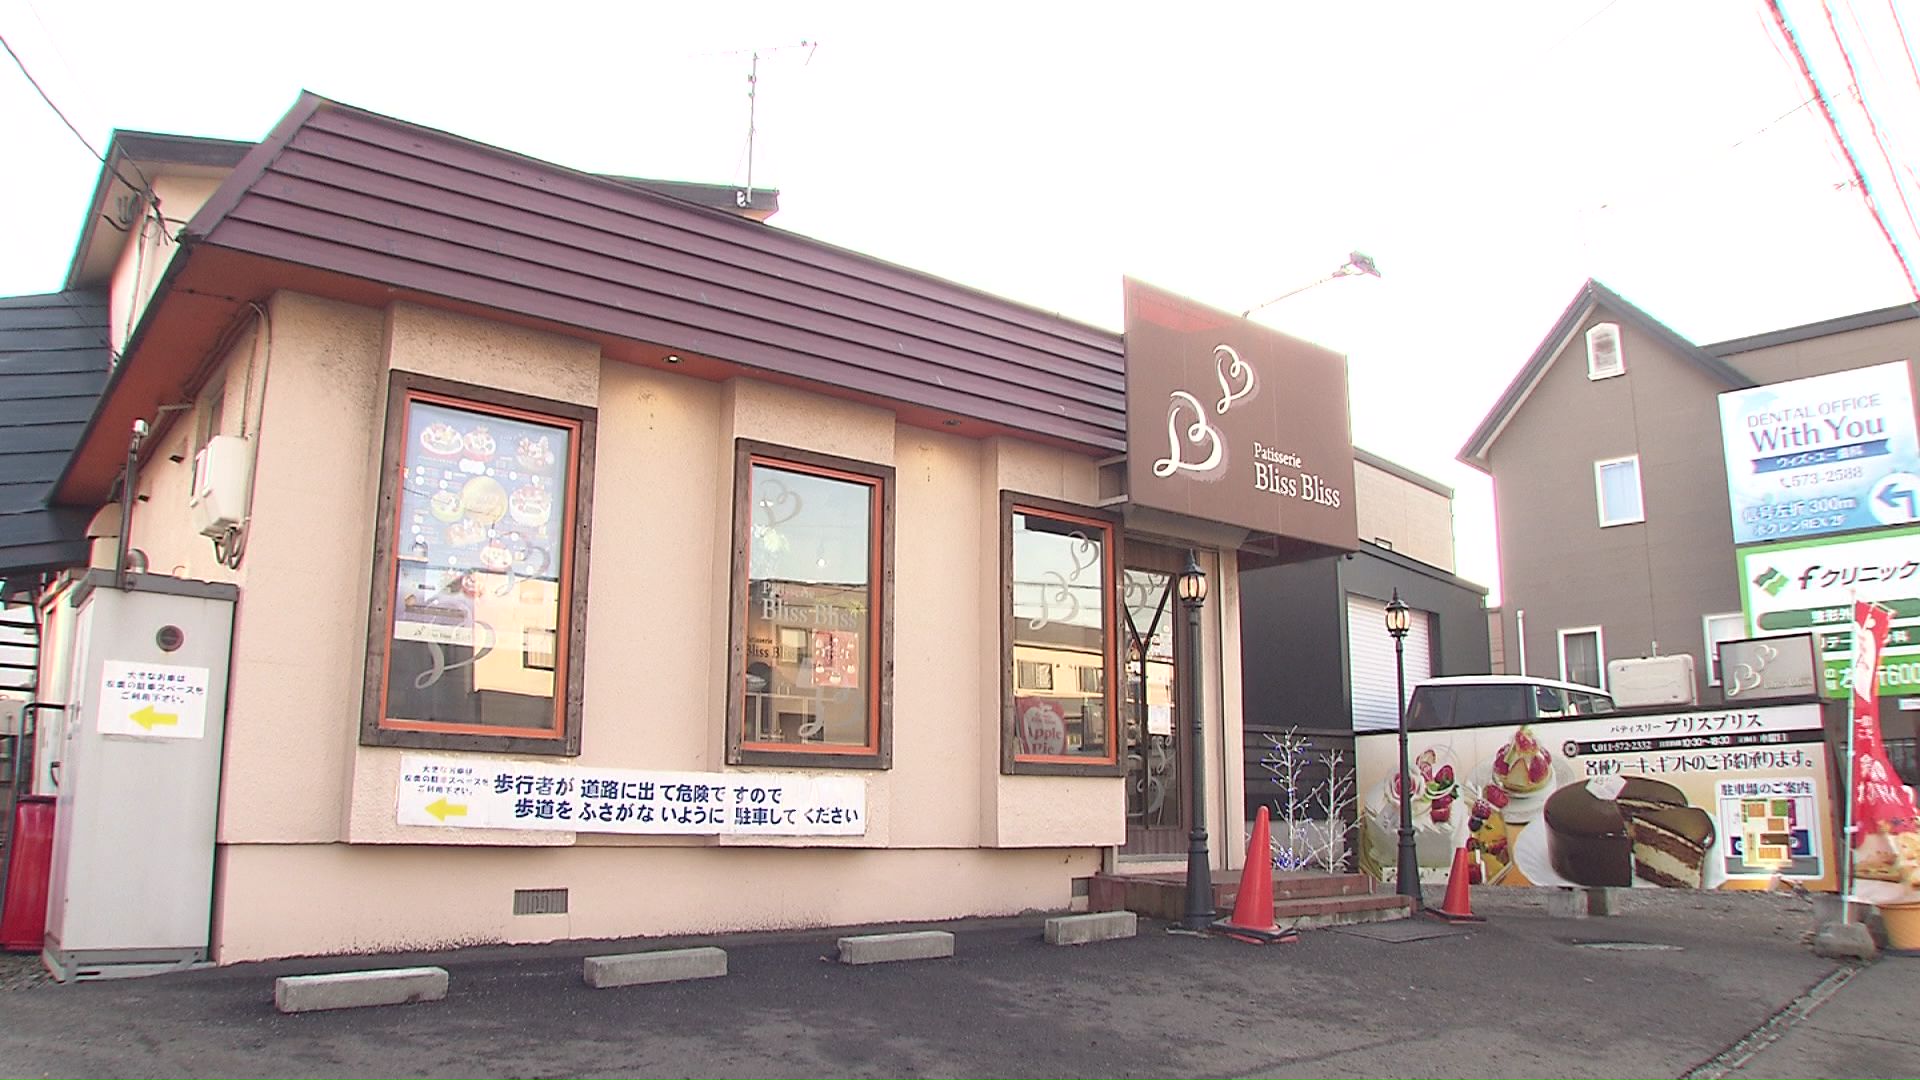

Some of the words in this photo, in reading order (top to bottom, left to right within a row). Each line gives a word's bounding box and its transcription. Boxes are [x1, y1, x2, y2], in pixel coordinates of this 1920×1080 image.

[1747, 405, 1816, 428] DENTAL
[1818, 393, 1882, 416] OFFICE
[1749, 421, 1821, 453] With
[1823, 415, 1884, 441] You
[1253, 441, 1302, 469] Patisserie
[1254, 461, 1297, 498] Bliss
[1300, 473, 1341, 509] Bliss
[760, 598, 808, 624] Bliss
[1027, 722, 1062, 740] Apple
